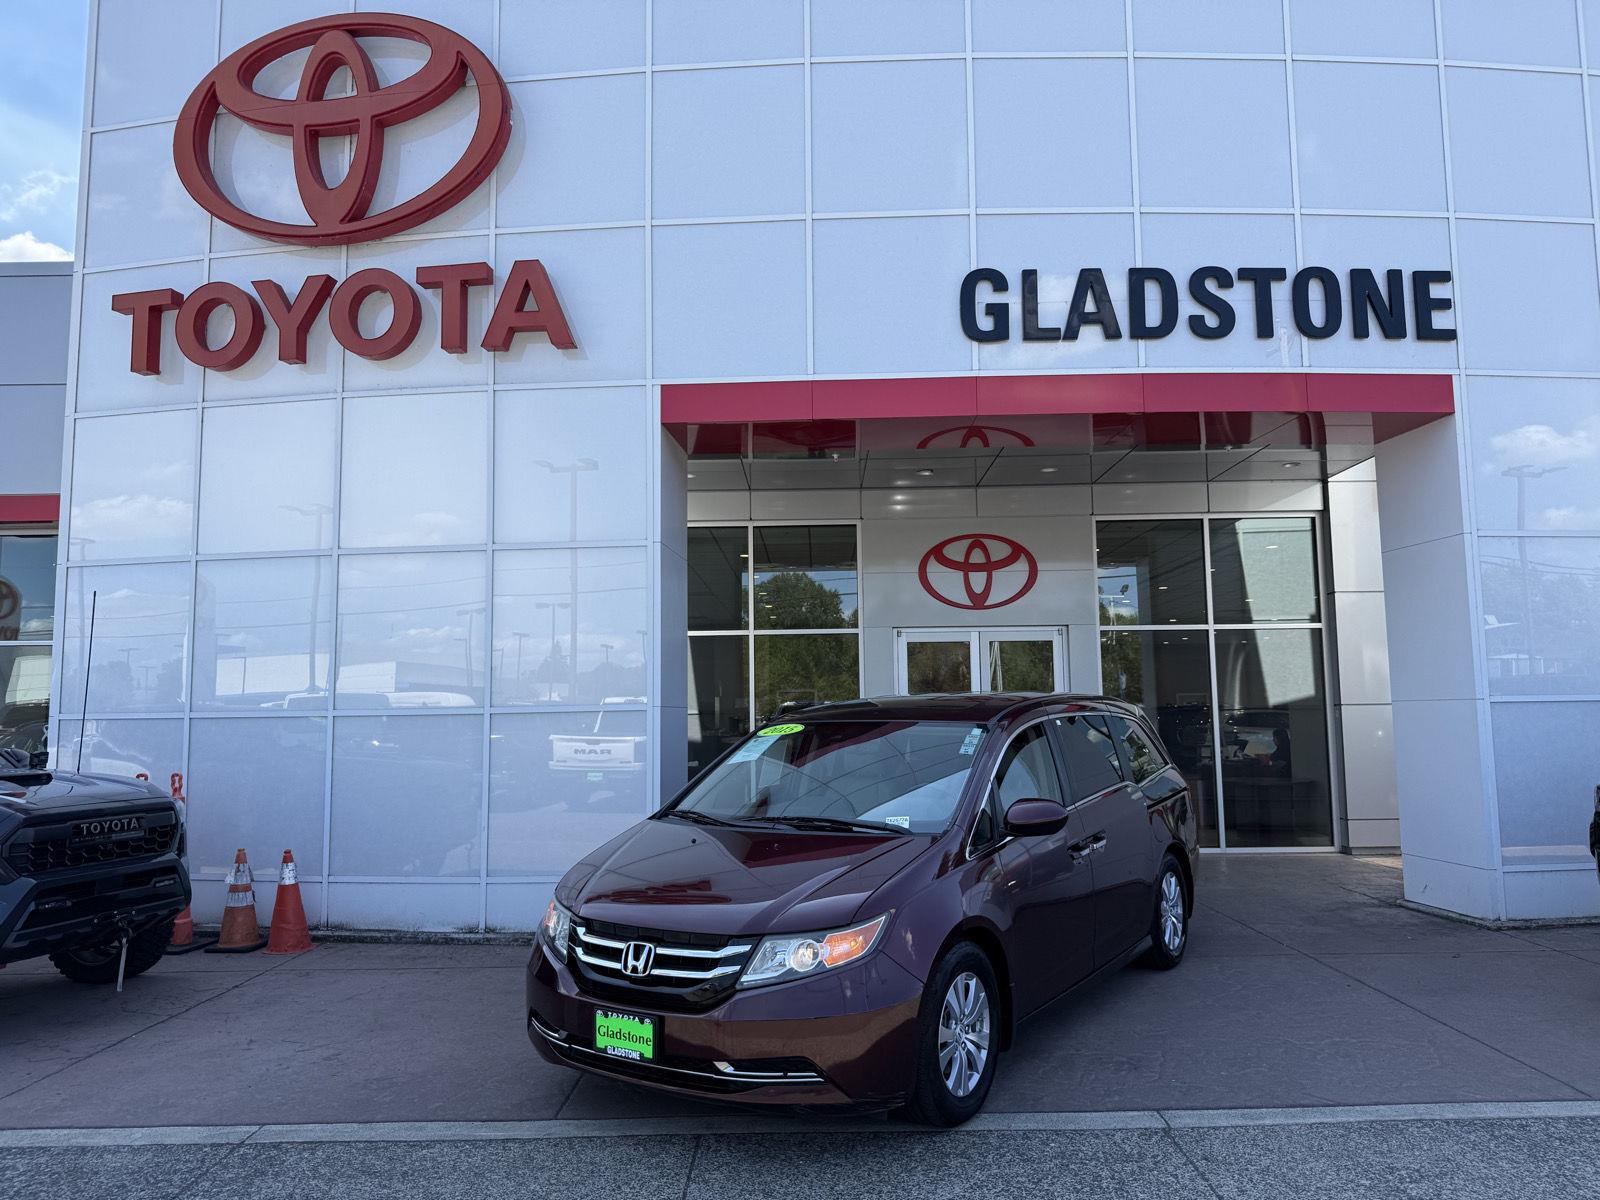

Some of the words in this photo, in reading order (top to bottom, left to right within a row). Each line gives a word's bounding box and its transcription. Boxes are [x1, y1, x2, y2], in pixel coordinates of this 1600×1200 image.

[960, 266, 1456, 341] GLADSTONE
[112, 259, 577, 376] TOYOTA
[81, 818, 139, 835] TOYOTA
[607, 1012, 640, 1023] TOYOTA
[598, 1024, 652, 1046] Gladstone
[607, 1046, 641, 1060] GLADSTONE
